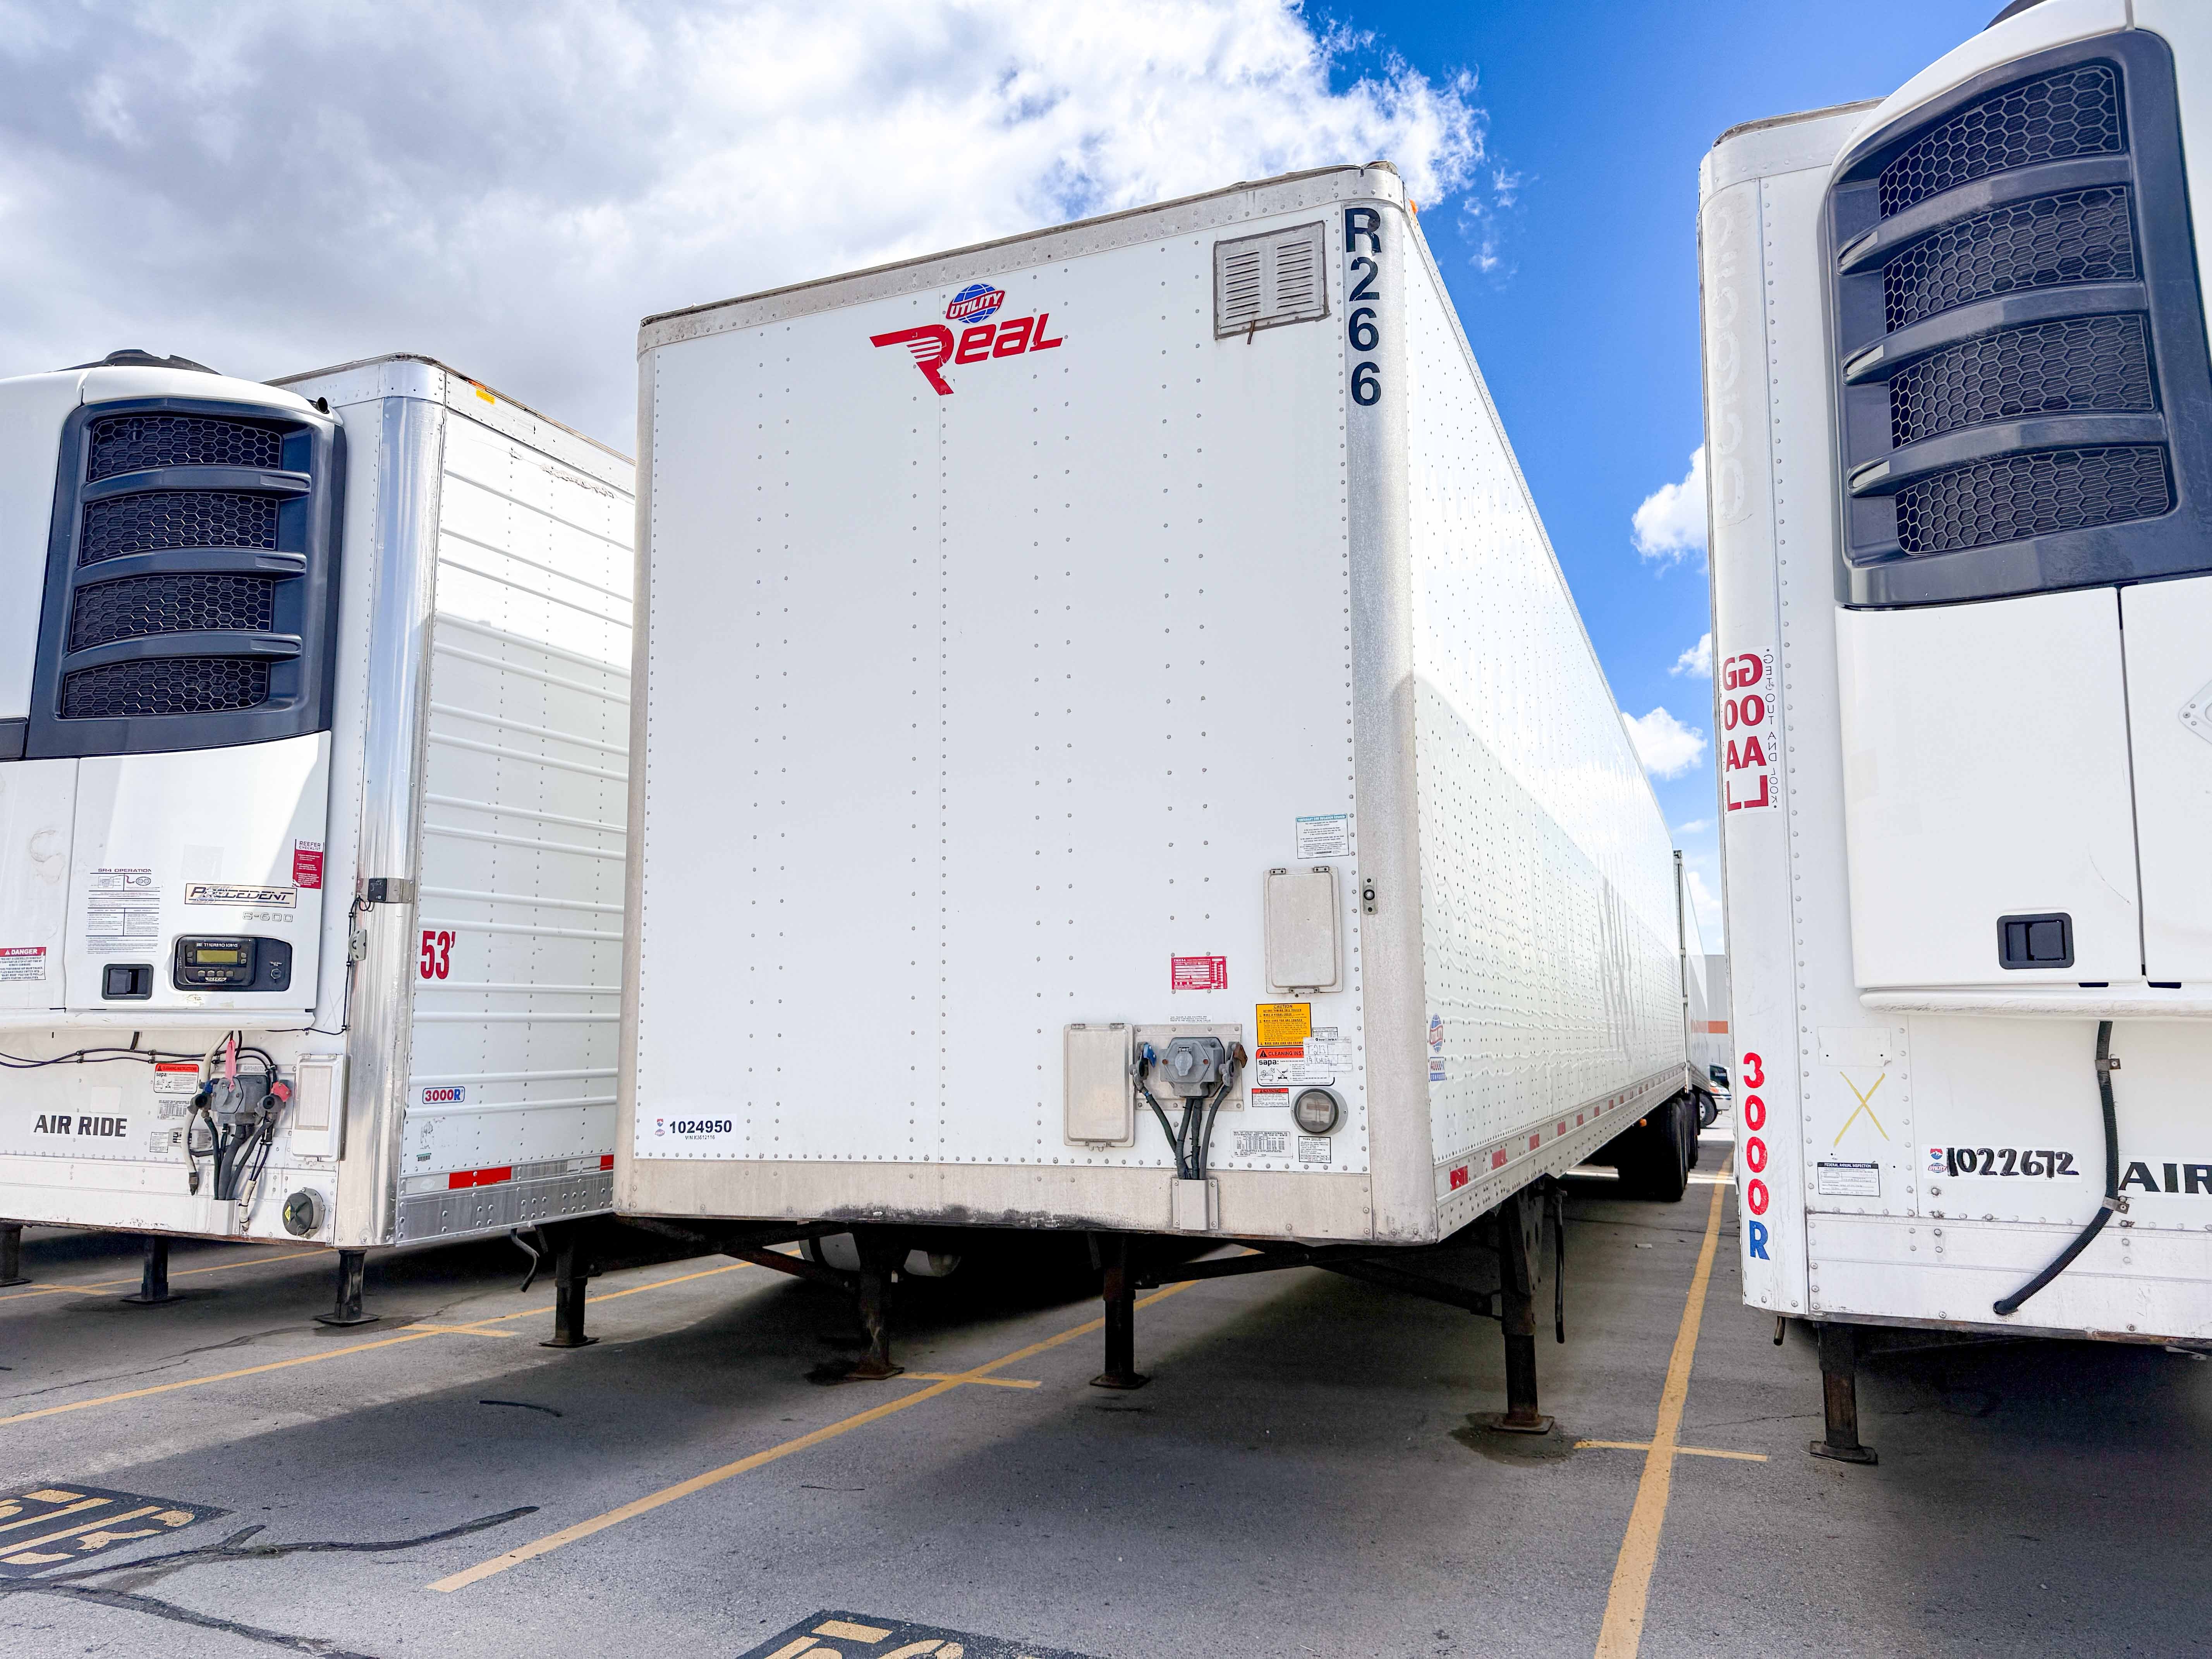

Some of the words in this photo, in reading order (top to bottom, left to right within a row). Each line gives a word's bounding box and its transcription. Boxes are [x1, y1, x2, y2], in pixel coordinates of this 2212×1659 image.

[950, 292, 1002, 318] UTILITY
[1345, 207, 1382, 406] R266
[243, 911, 293, 922] S-600
[1430, 1027, 1444, 1043] UTILITY
[33, 1115, 72, 1134] AIR
[77, 1116, 127, 1137] RIDE
[670, 1120, 732, 1133] 1024950
[1743, 1052, 1770, 1261] 3000R
[1946, 1147, 2080, 1180] 1022672
[2118, 1162, 2212, 1194] AIR
